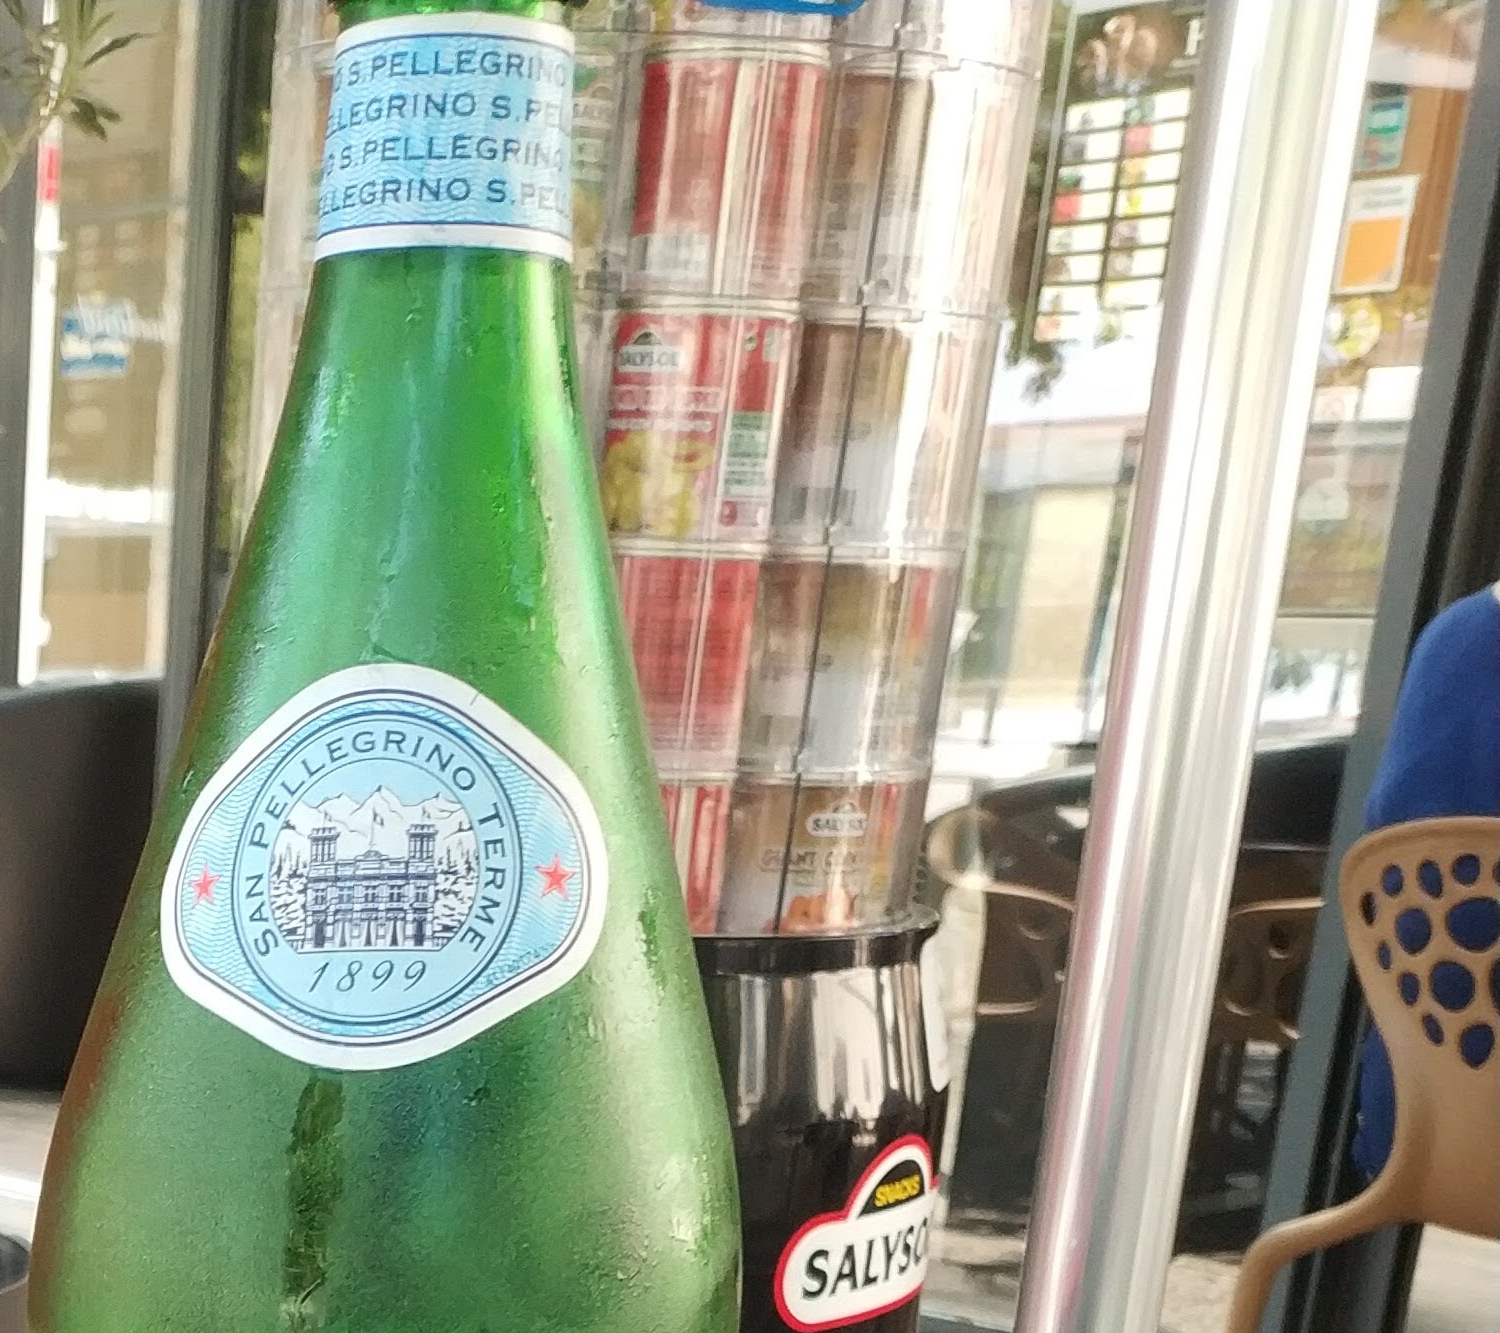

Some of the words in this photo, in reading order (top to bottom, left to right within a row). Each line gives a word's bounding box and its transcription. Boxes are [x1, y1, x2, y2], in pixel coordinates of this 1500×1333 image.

[249, 729, 477, 850] PELLEGRINO
[247, 872, 281, 957] SAN
[458, 801, 504, 953] TERME
[307, 959, 428, 994] 1899
